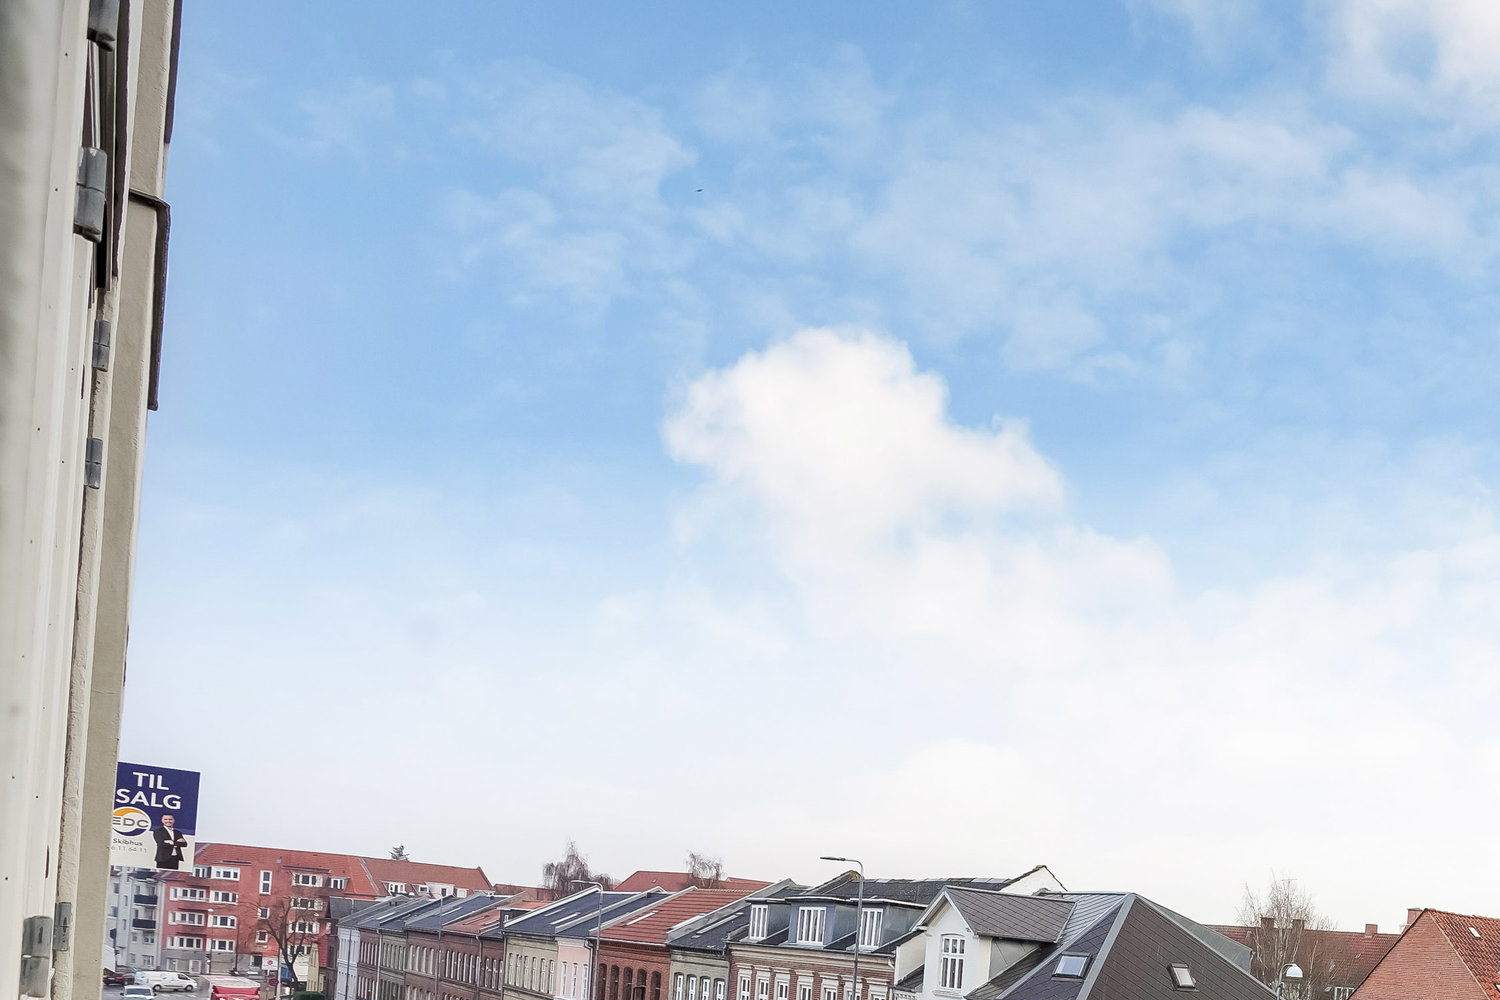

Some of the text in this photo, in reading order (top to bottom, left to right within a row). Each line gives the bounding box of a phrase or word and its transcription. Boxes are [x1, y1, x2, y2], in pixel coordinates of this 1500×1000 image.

[132, 772, 170, 790] TIL
[116, 788, 182, 810] SALG
[112, 816, 149, 828] EDC
[112, 838, 143, 846] Skibhus
